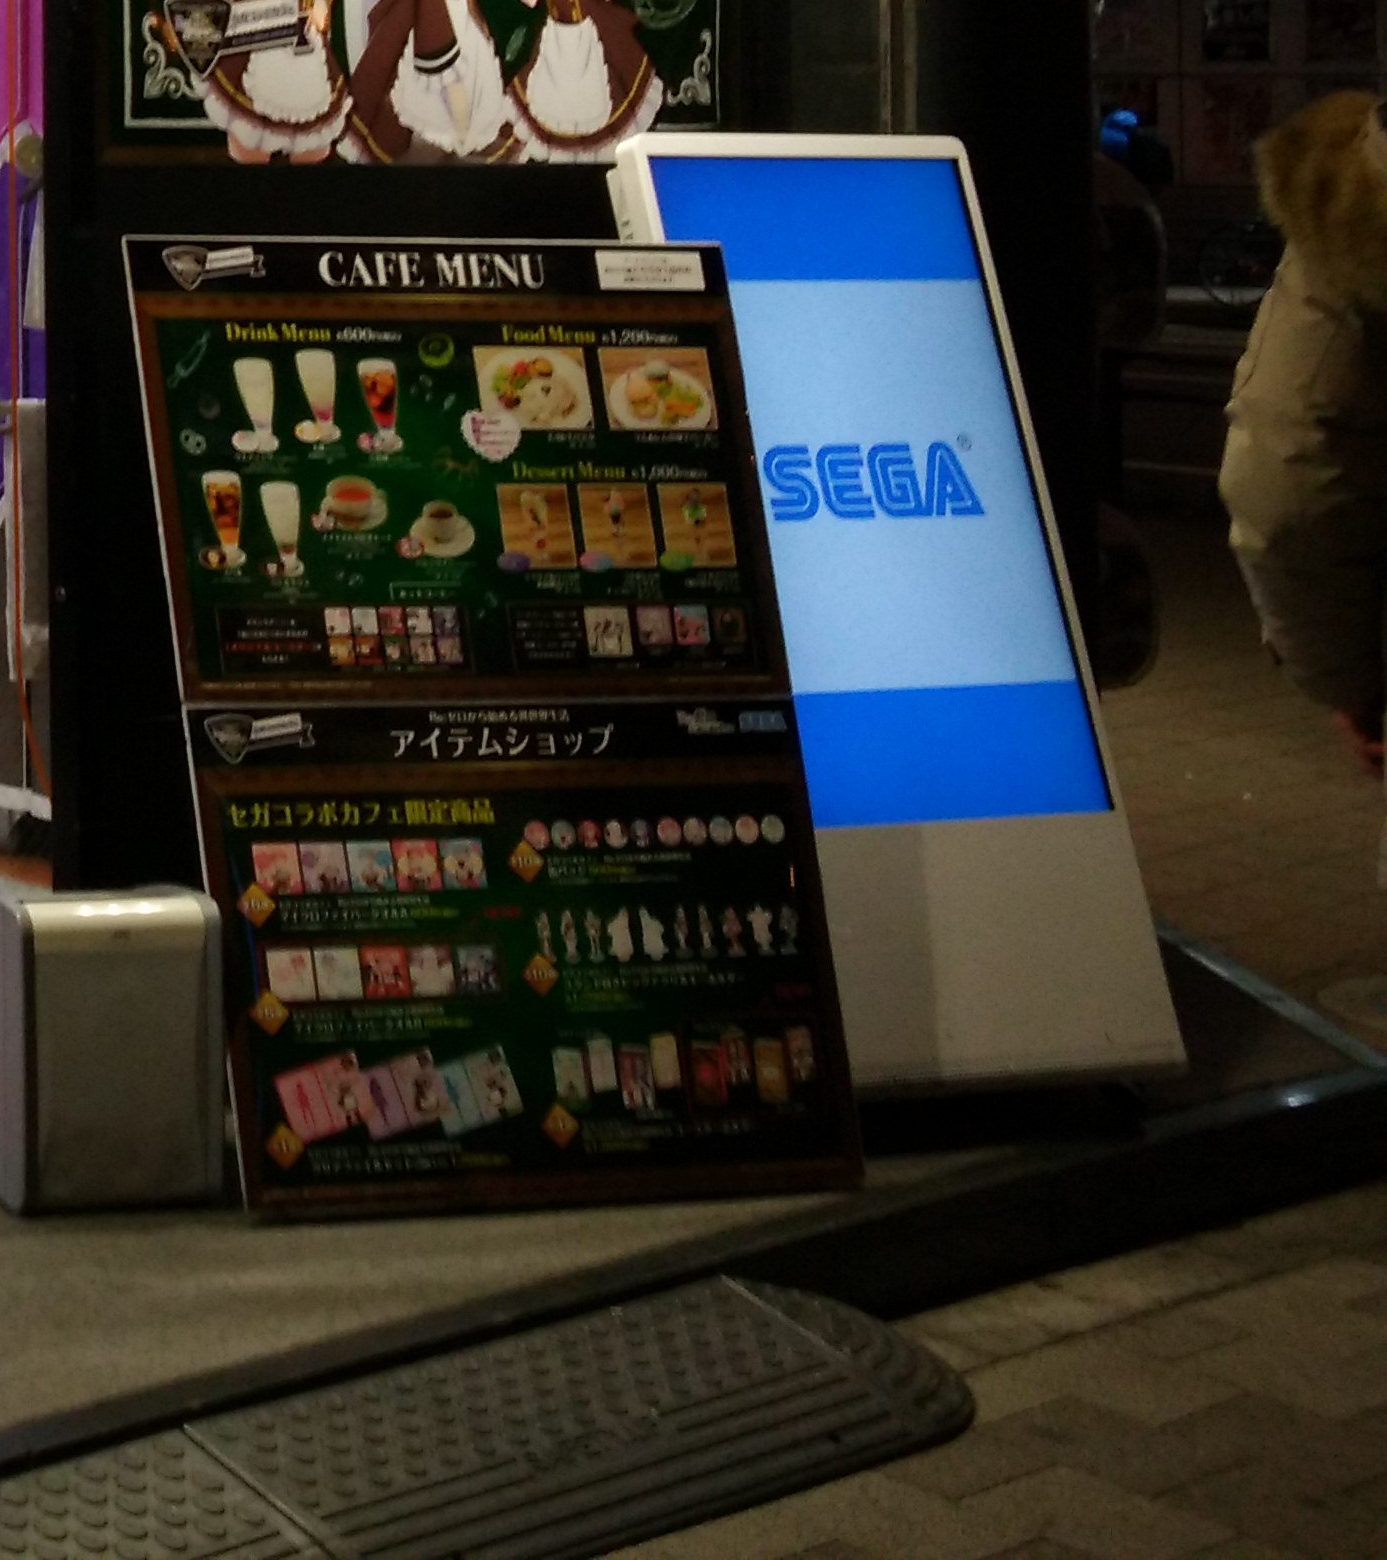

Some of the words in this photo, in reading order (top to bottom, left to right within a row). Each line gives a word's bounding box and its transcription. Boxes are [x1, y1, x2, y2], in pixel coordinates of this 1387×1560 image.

[318, 250, 425, 289] CAFE
[434, 251, 545, 290] MENU
[763, 441, 985, 521] SEGA
[388, 721, 615, 760] アイテムショップ
